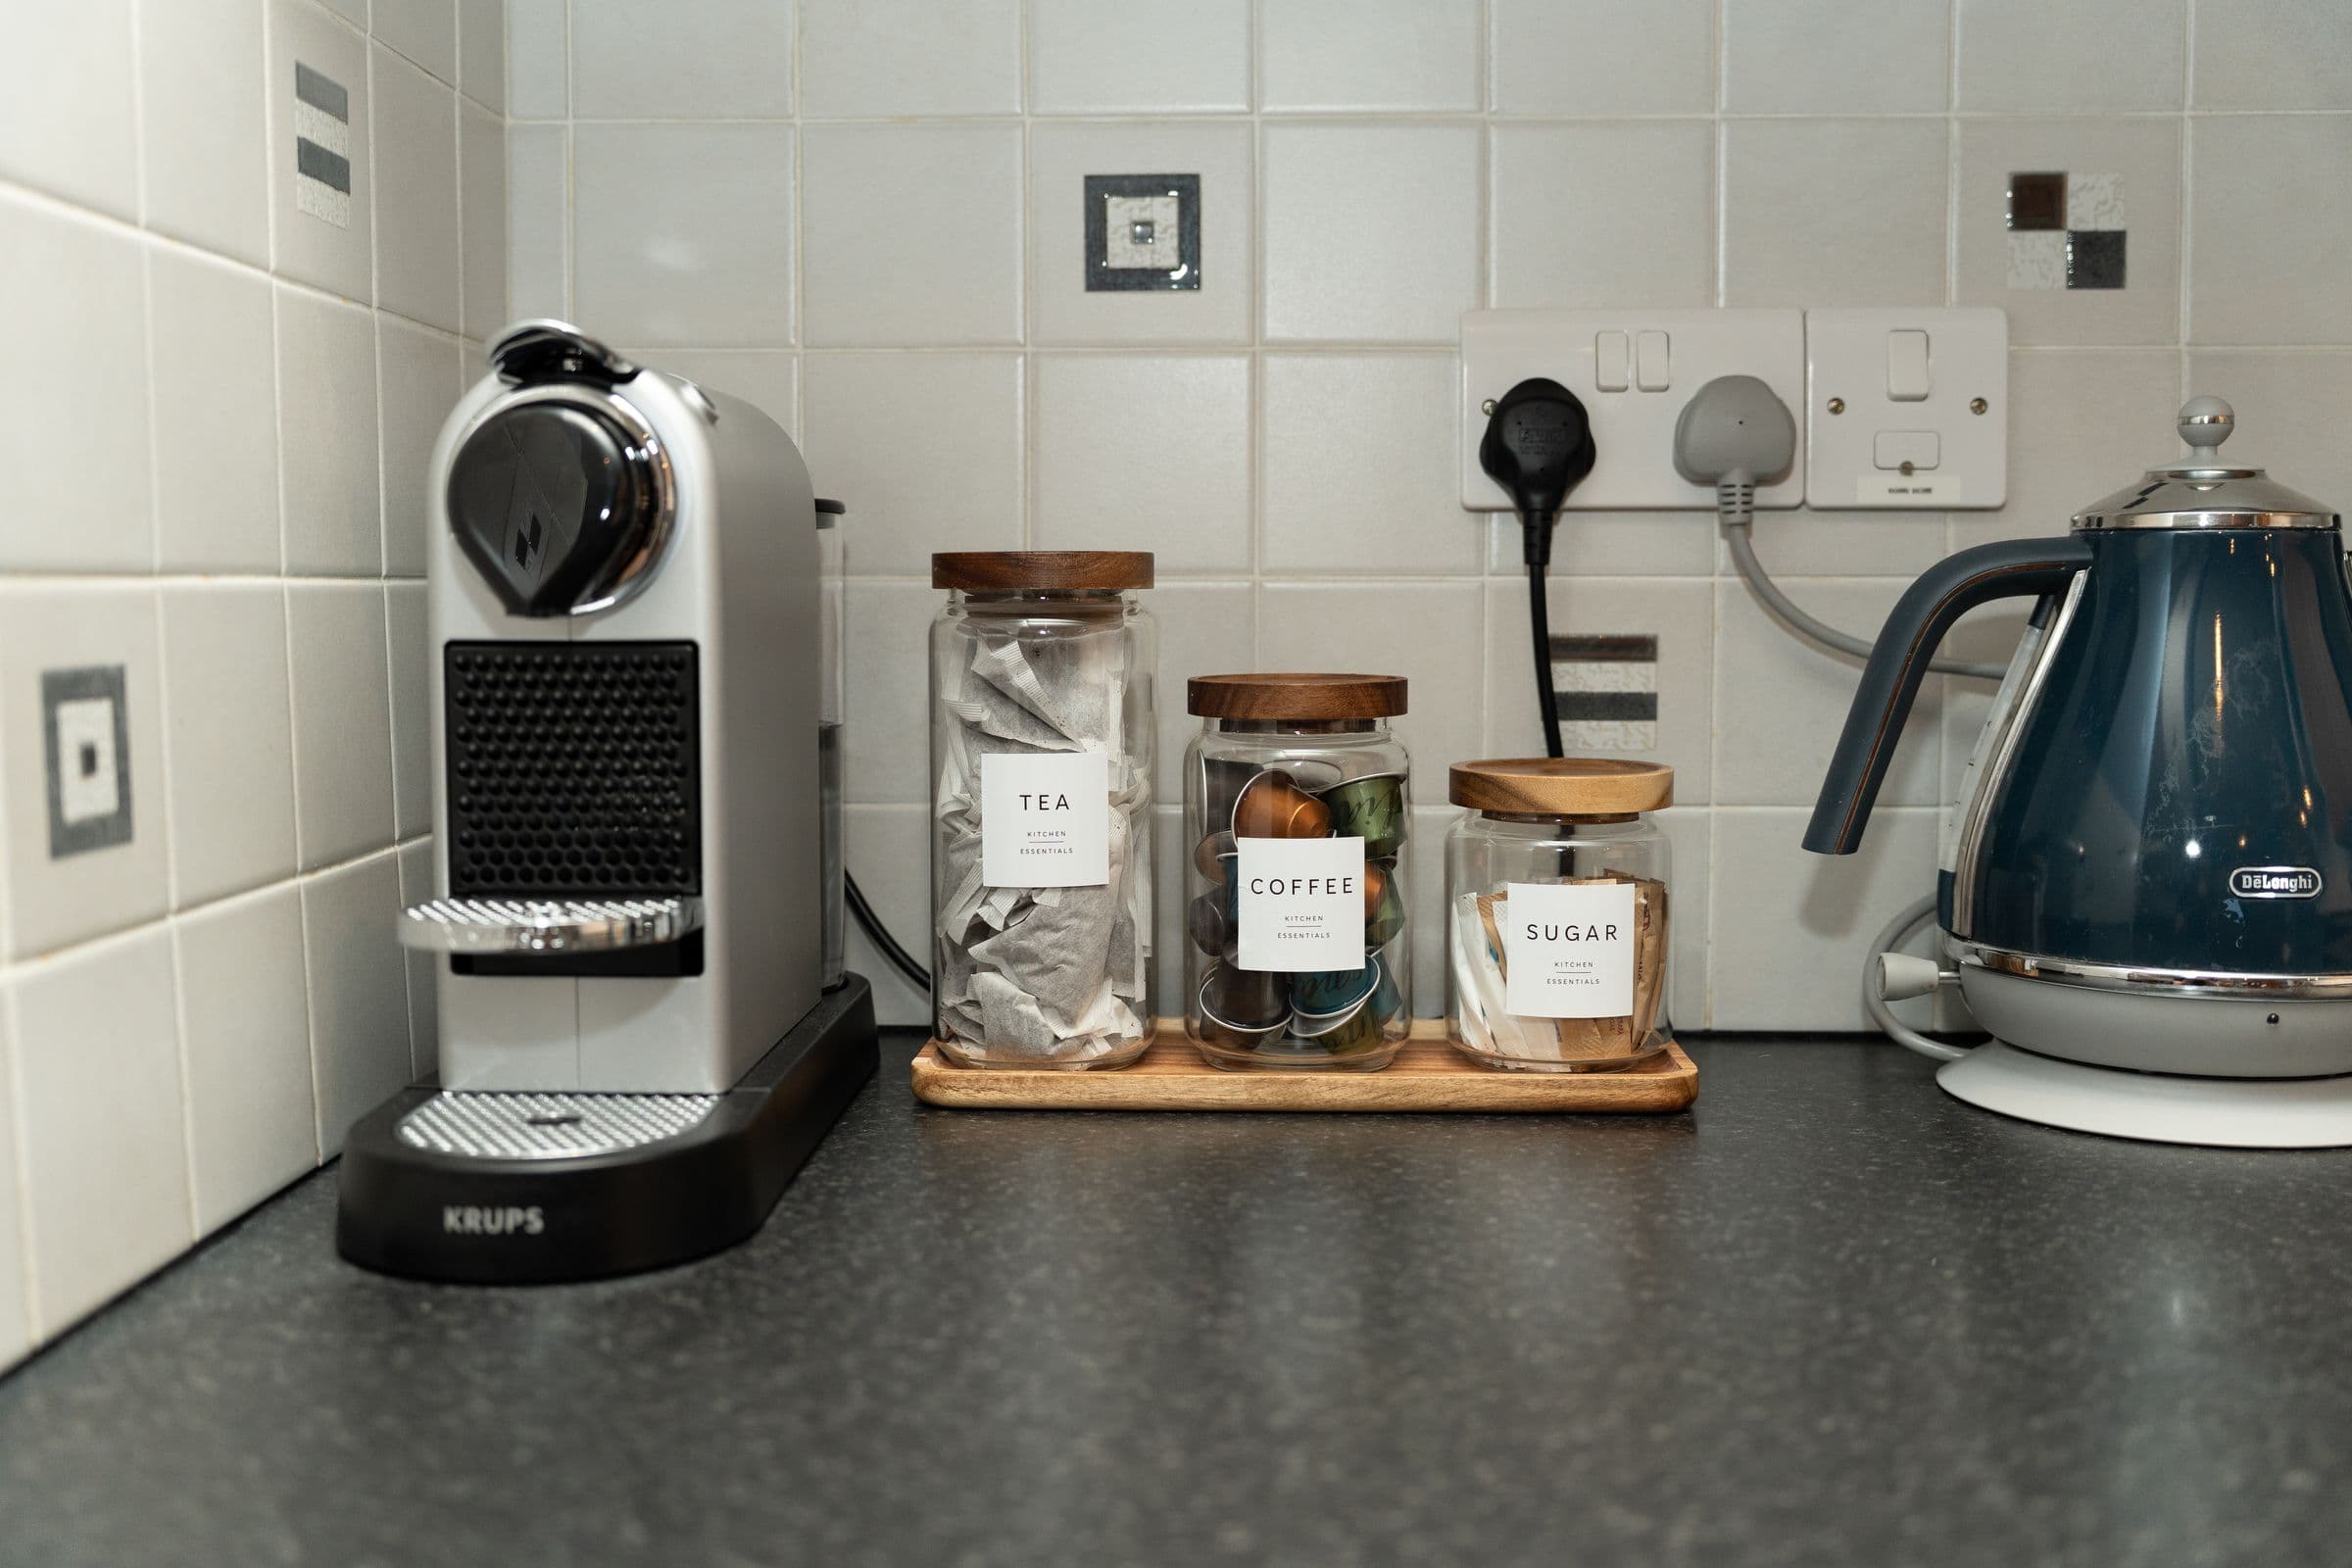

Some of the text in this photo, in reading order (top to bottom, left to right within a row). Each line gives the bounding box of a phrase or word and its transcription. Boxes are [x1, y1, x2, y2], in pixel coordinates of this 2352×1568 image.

[1018, 793, 1070, 811] TEA
[1250, 876, 1353, 896] COFFEE
[1526, 923, 1618, 942] SUGAR
[443, 1206, 545, 1235] KRUPS
